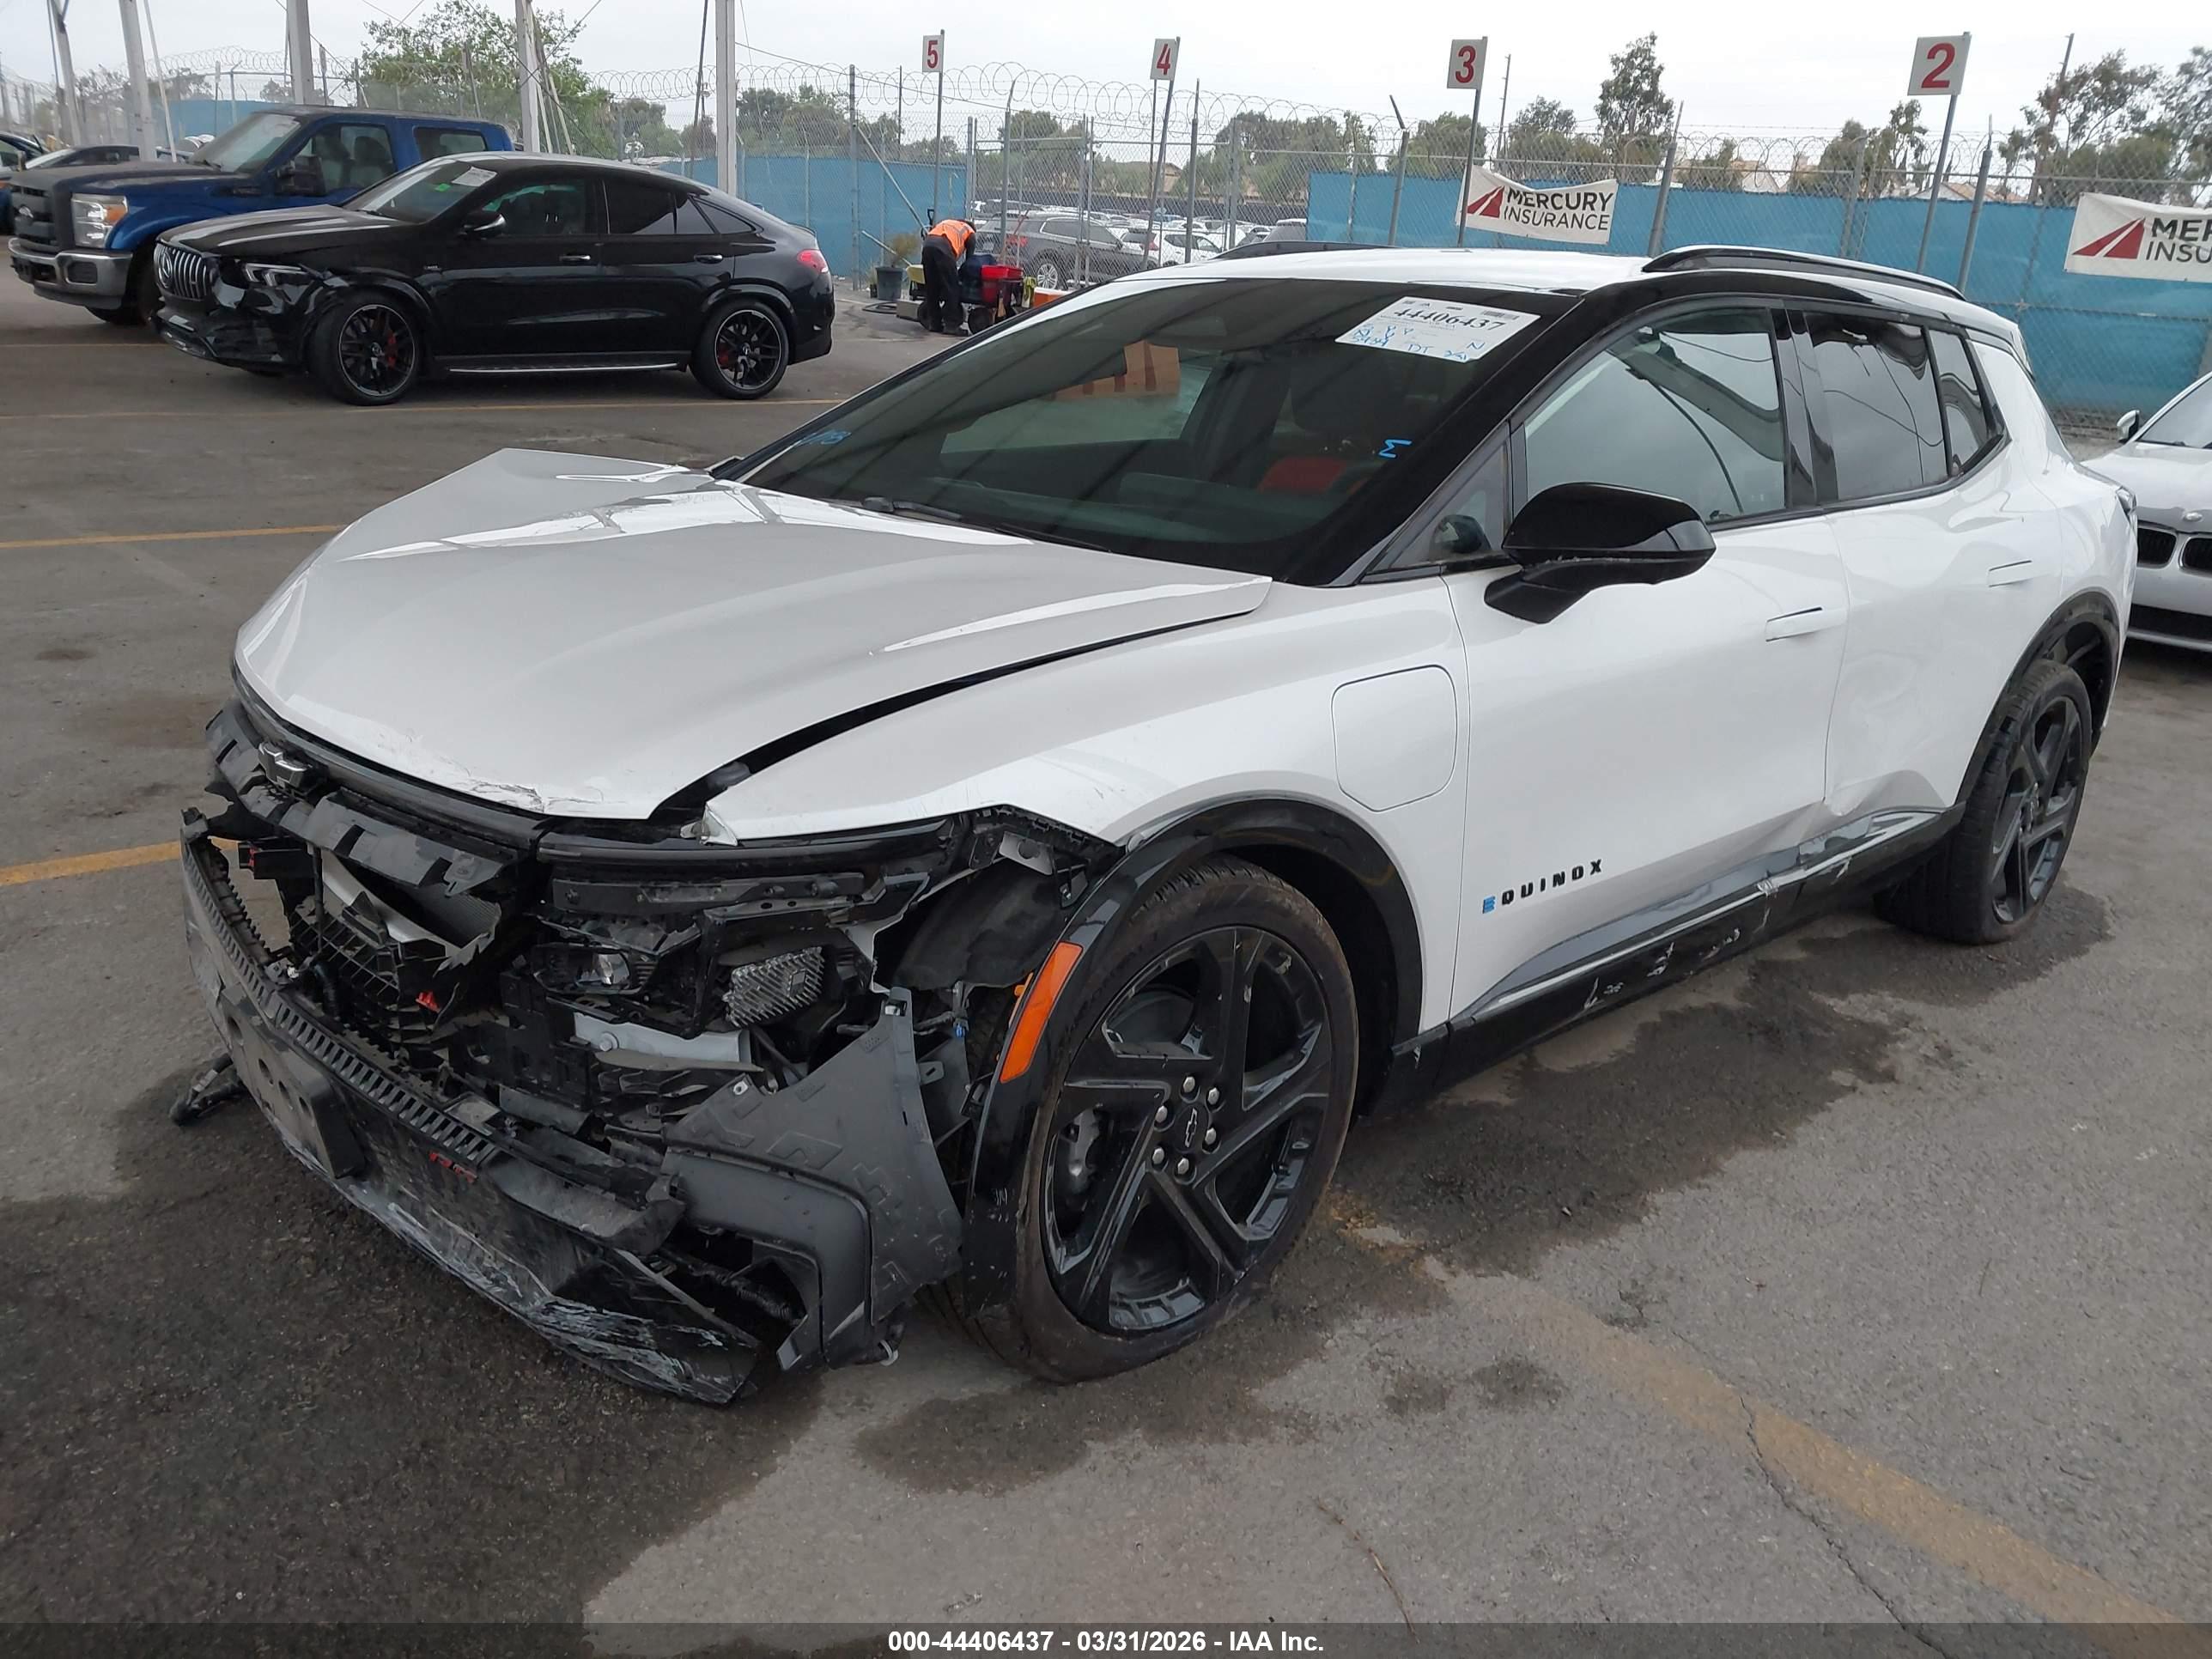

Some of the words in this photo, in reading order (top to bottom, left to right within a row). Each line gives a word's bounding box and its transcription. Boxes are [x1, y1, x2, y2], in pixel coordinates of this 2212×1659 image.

[927, 40, 939, 69] 5
[1156, 43, 1171, 76] 4
[1454, 46, 1477, 83] 3
[1922, 43, 1956, 88] 2
[1507, 186, 1613, 212] MERCURY
[1504, 205, 1610, 231] INSURANCE
[1394, 308, 1506, 331] 44406437
[1482, 859, 1602, 915] EQUINOX
